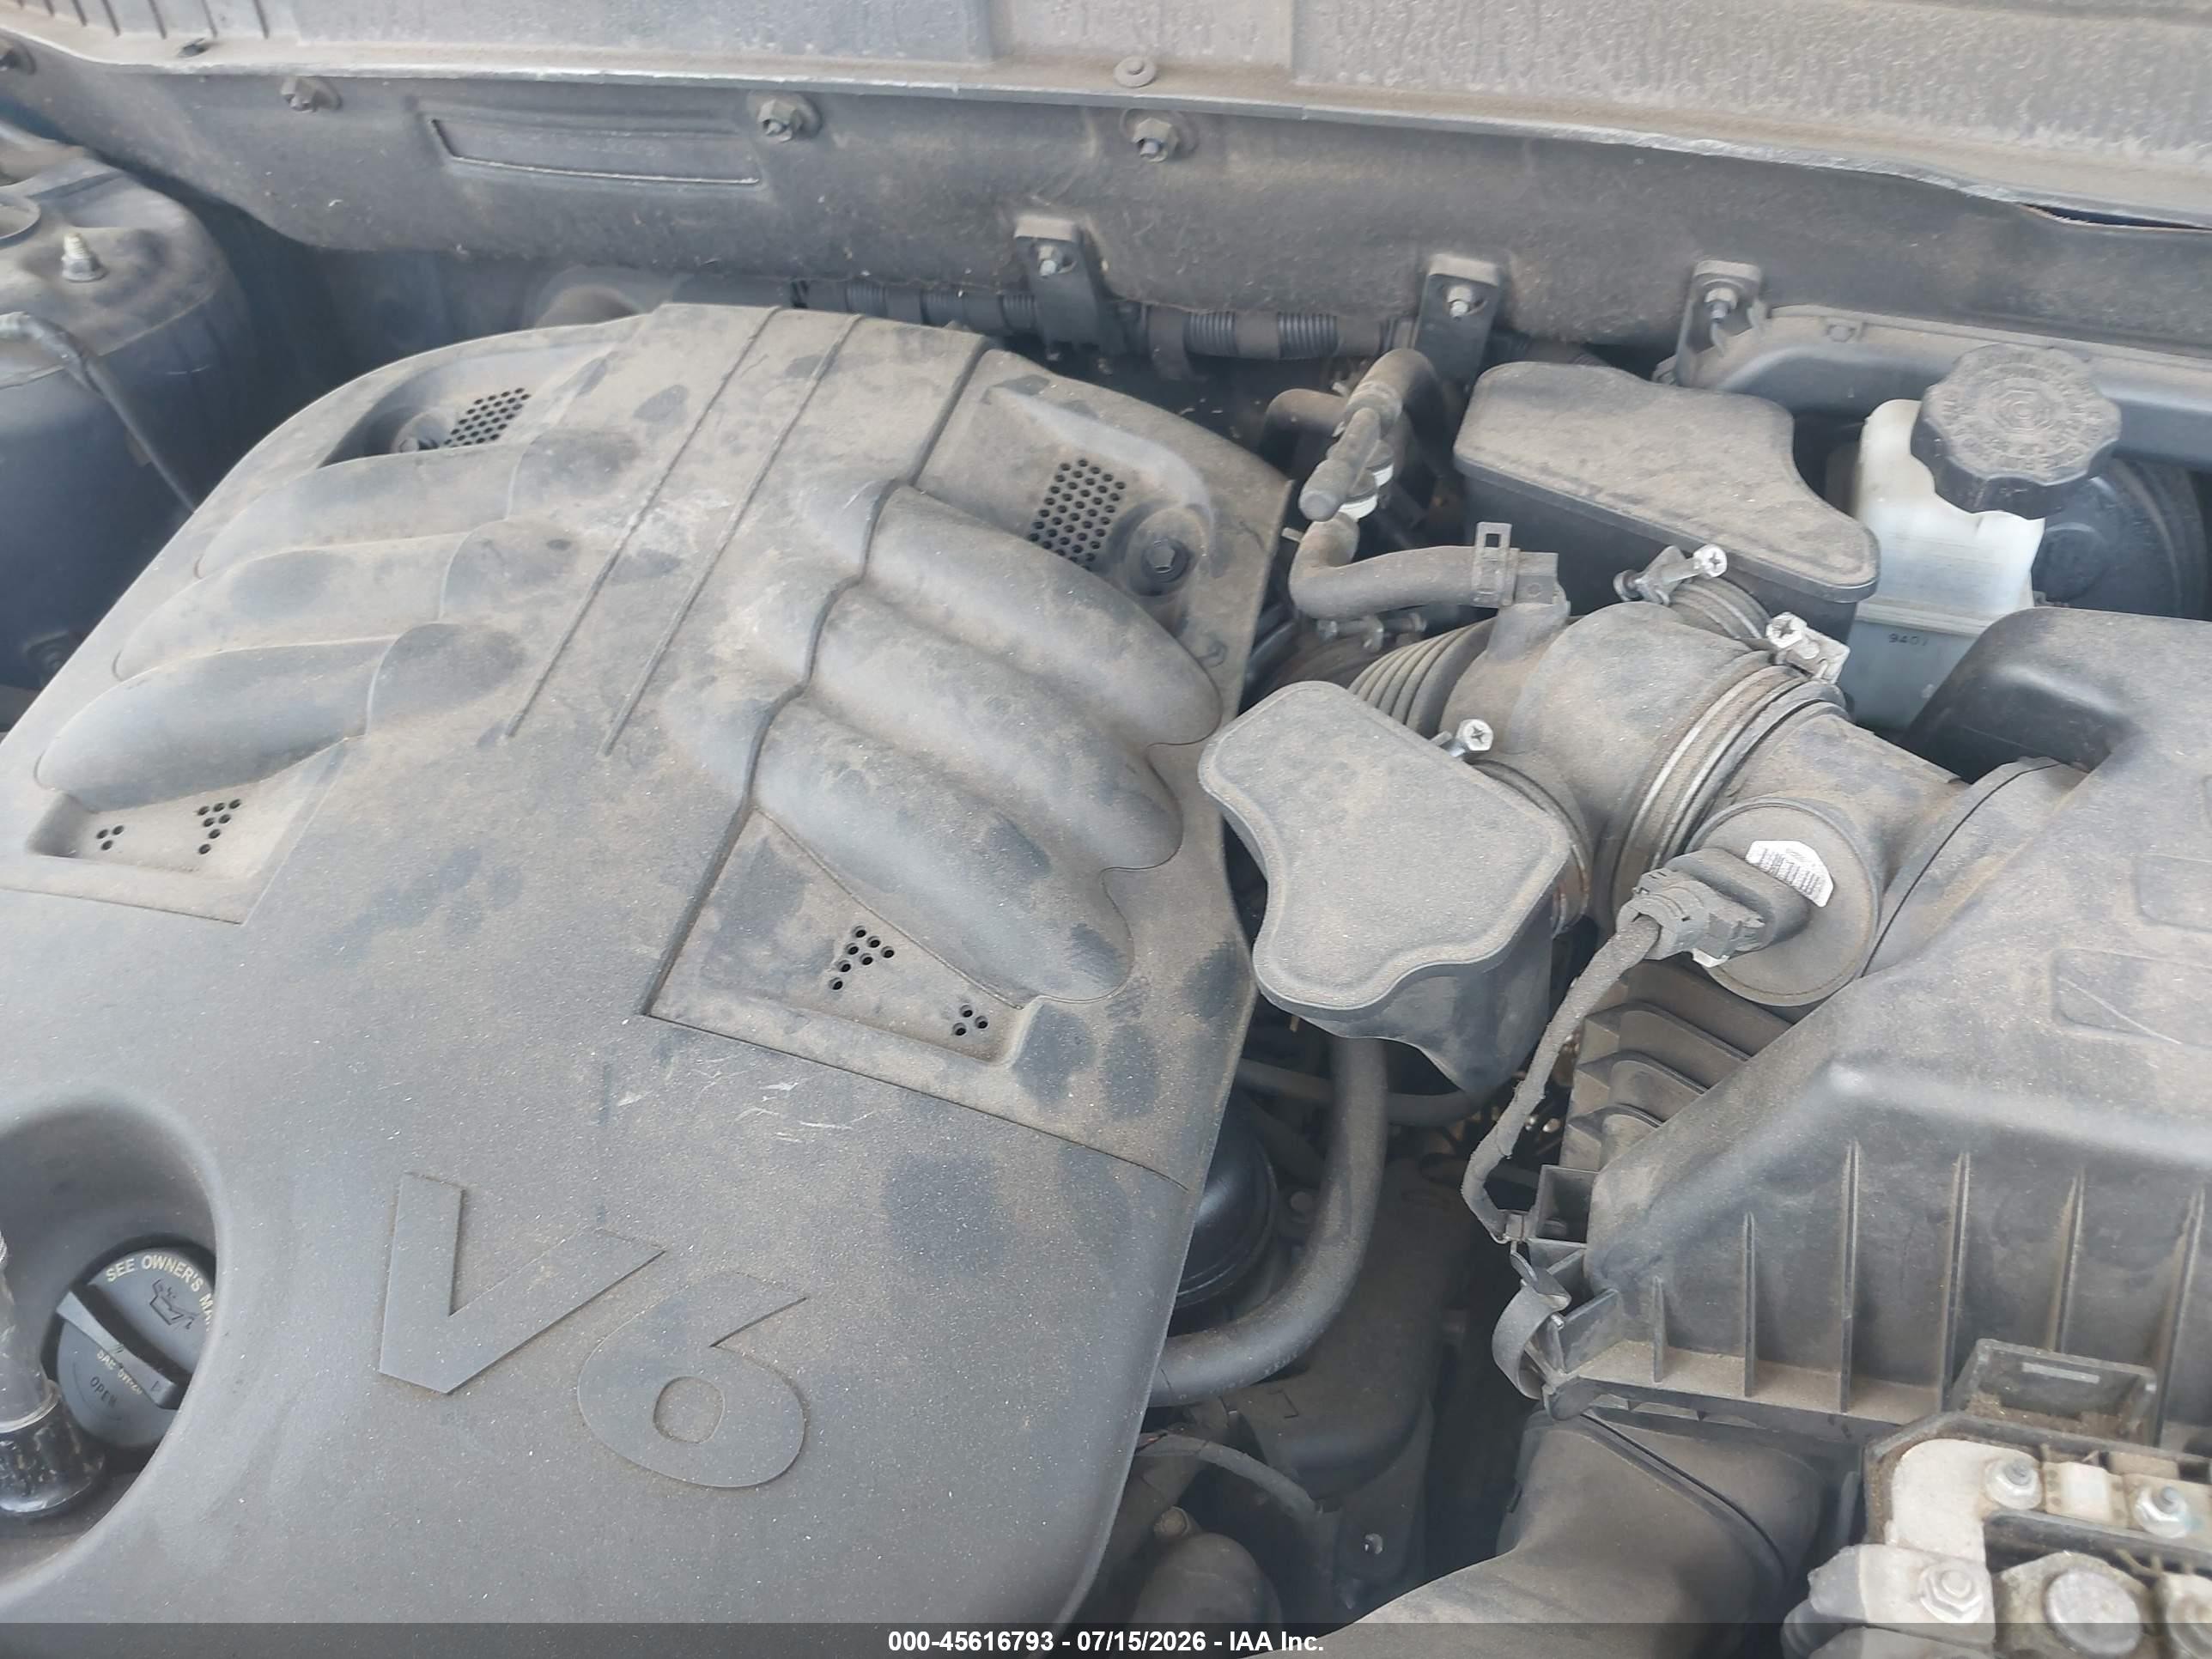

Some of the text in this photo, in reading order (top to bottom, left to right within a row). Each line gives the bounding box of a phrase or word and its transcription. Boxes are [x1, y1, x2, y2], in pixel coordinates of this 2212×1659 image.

[106, 1258, 136, 1282] SEE
[141, 1255, 204, 1292] OWNER'S
[379, 1171, 807, 1489] V6
[89, 1376, 118, 1409] OPEN
